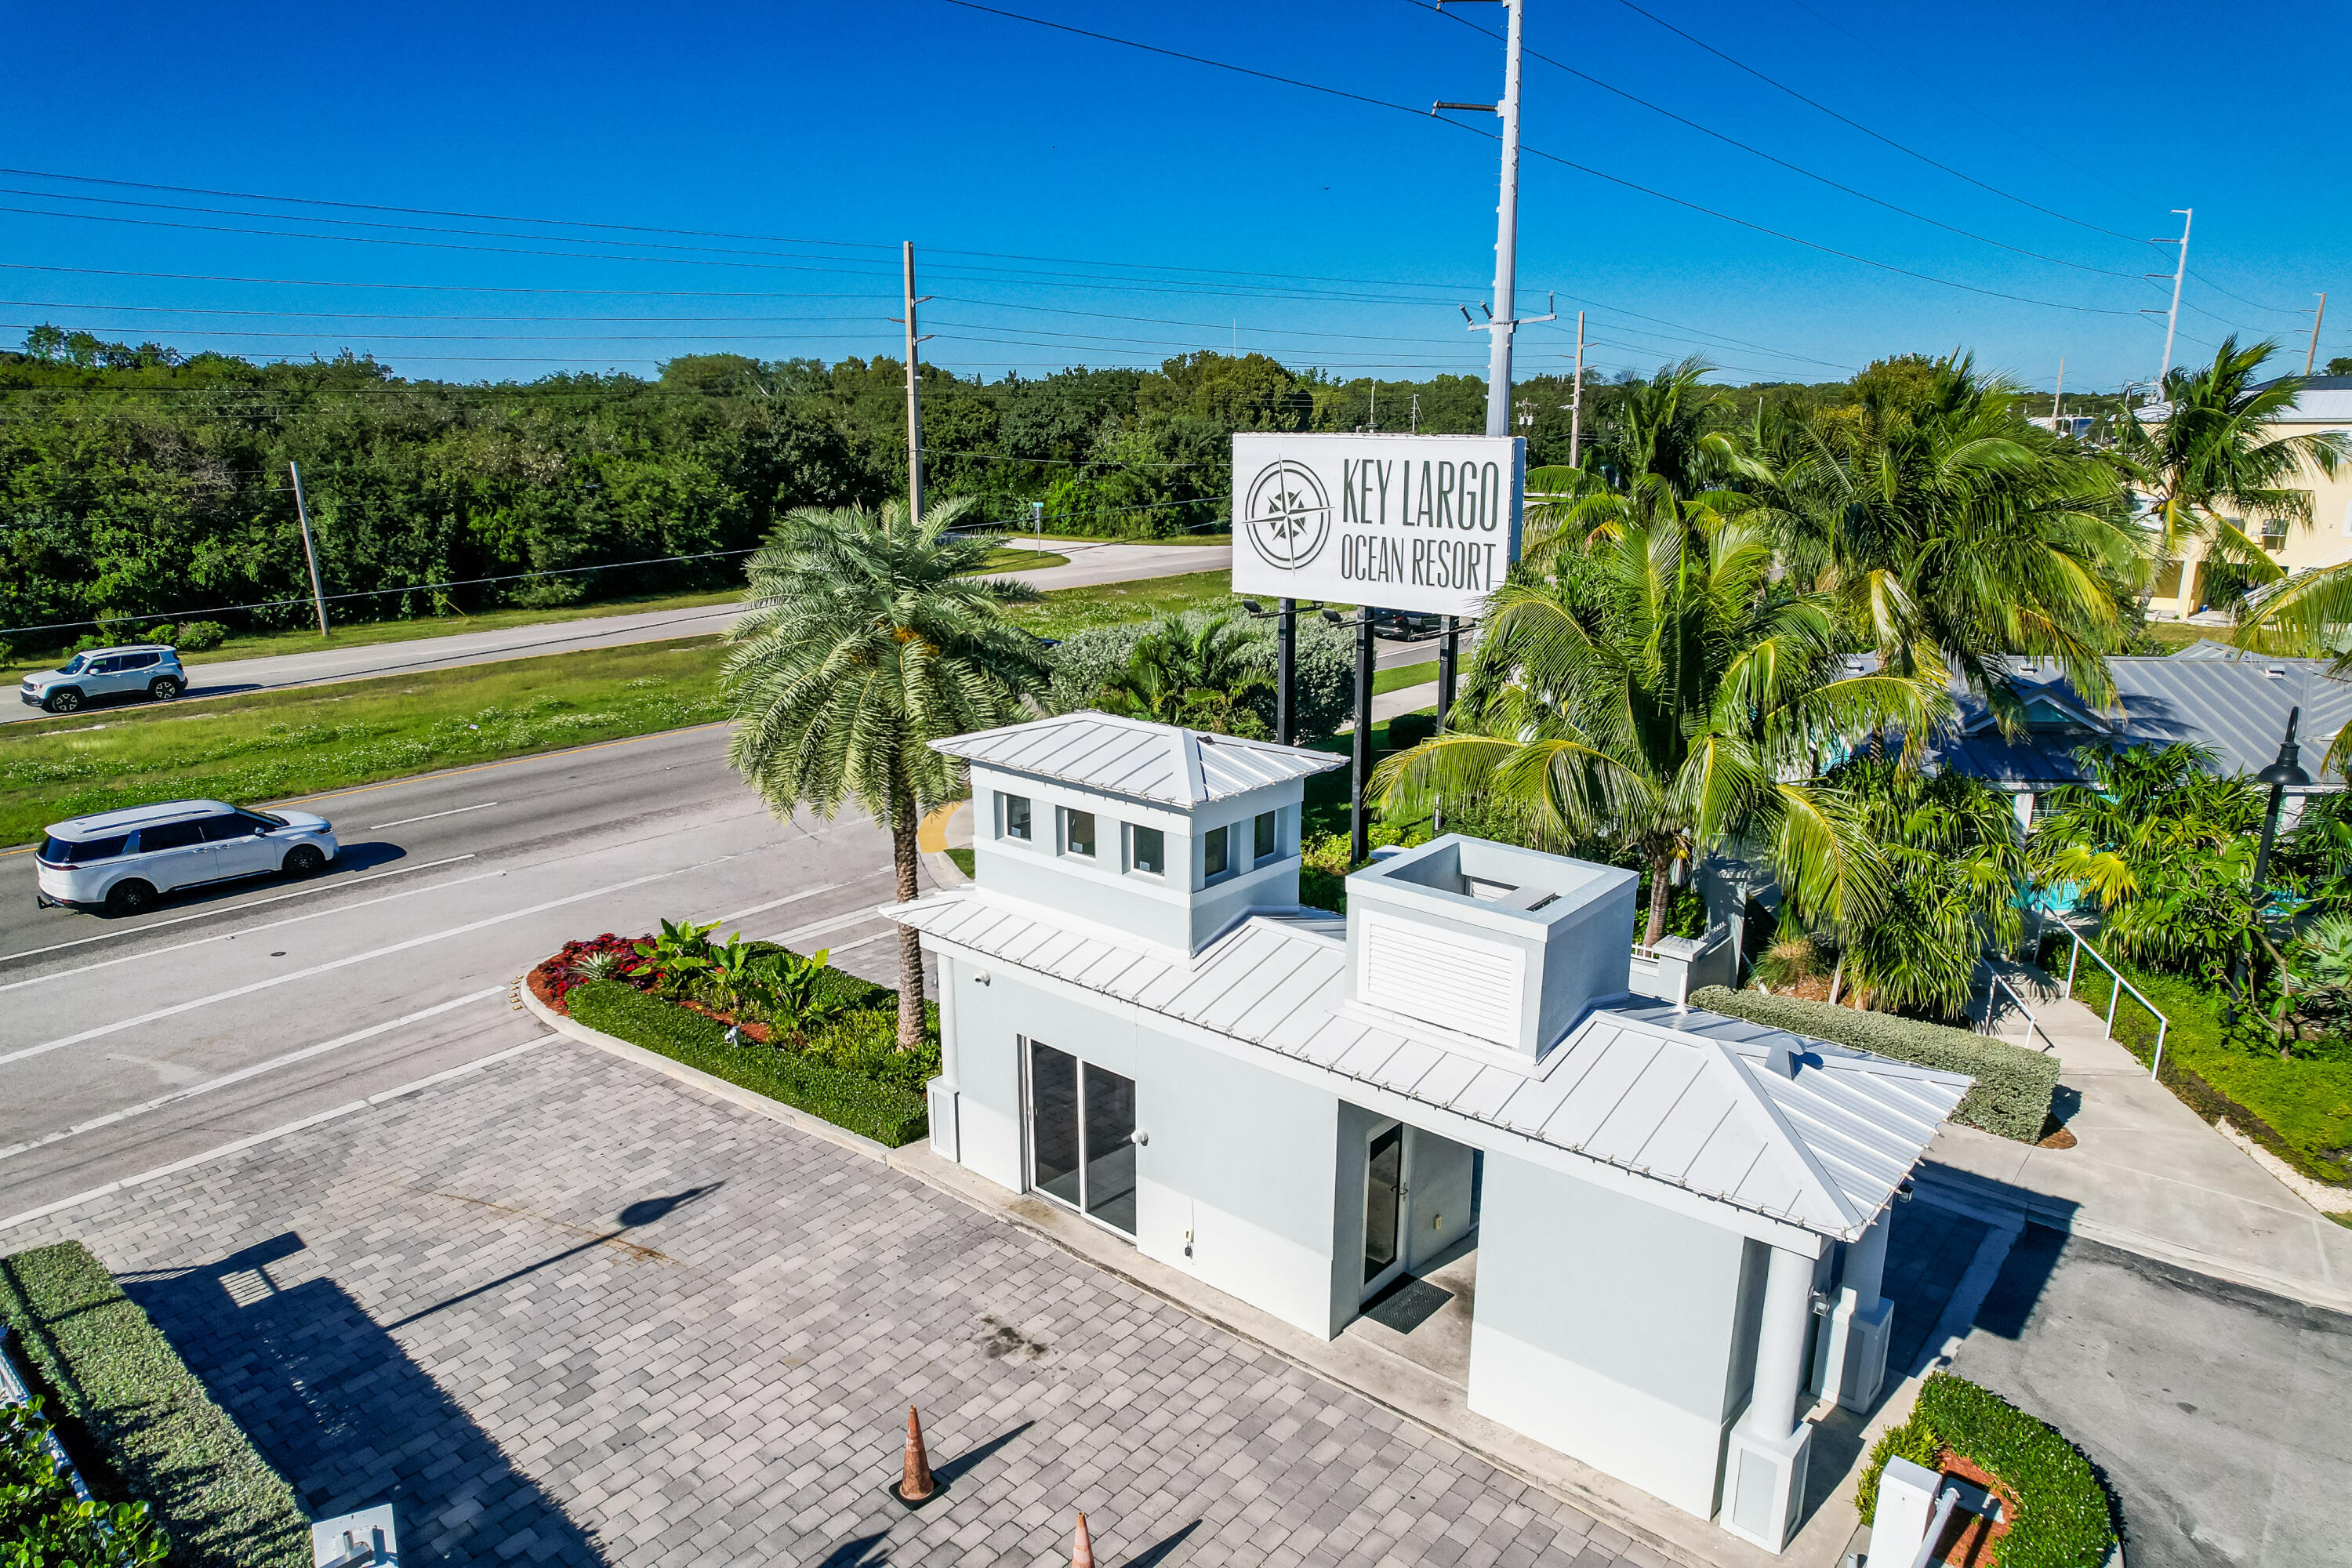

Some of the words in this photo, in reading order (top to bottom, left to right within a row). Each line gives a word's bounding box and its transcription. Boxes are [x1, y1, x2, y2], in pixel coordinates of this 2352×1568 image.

[1342, 459, 1392, 524] KEY
[1403, 459, 1499, 532] LARGO
[1341, 533, 1404, 583] OCEAN
[1412, 539, 1497, 591] RESORT
